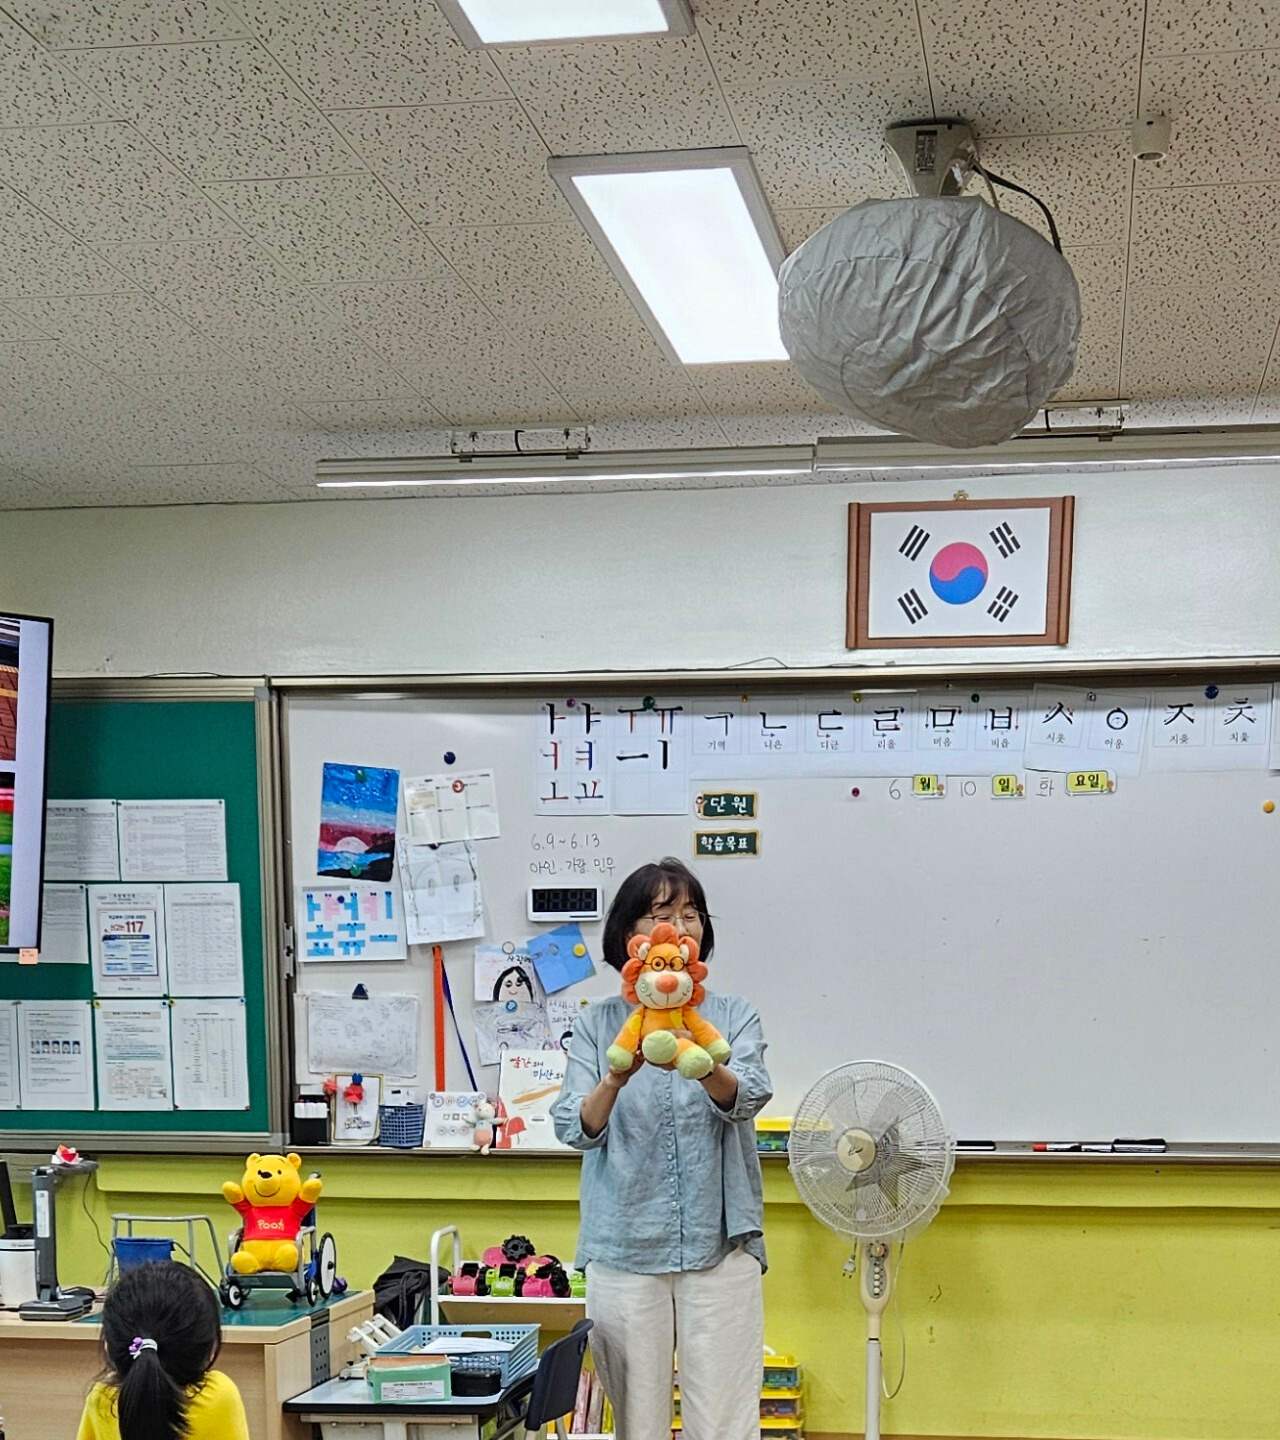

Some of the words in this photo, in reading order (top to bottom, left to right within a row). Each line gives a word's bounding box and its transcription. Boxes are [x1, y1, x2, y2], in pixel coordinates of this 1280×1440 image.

[707, 740, 726, 751] 기역
[889, 779, 901, 800] 6
[918, 776, 932, 792] 월
[960, 780, 976, 798] 10
[998, 776, 1011, 793] 일
[1036, 776, 1055, 797] 화
[1074, 773, 1100, 789] 요일
[700, 835, 748, 852] 학습목표
[125, 921, 144, 933] 117
[257, 1219, 284, 1231] Pooh
